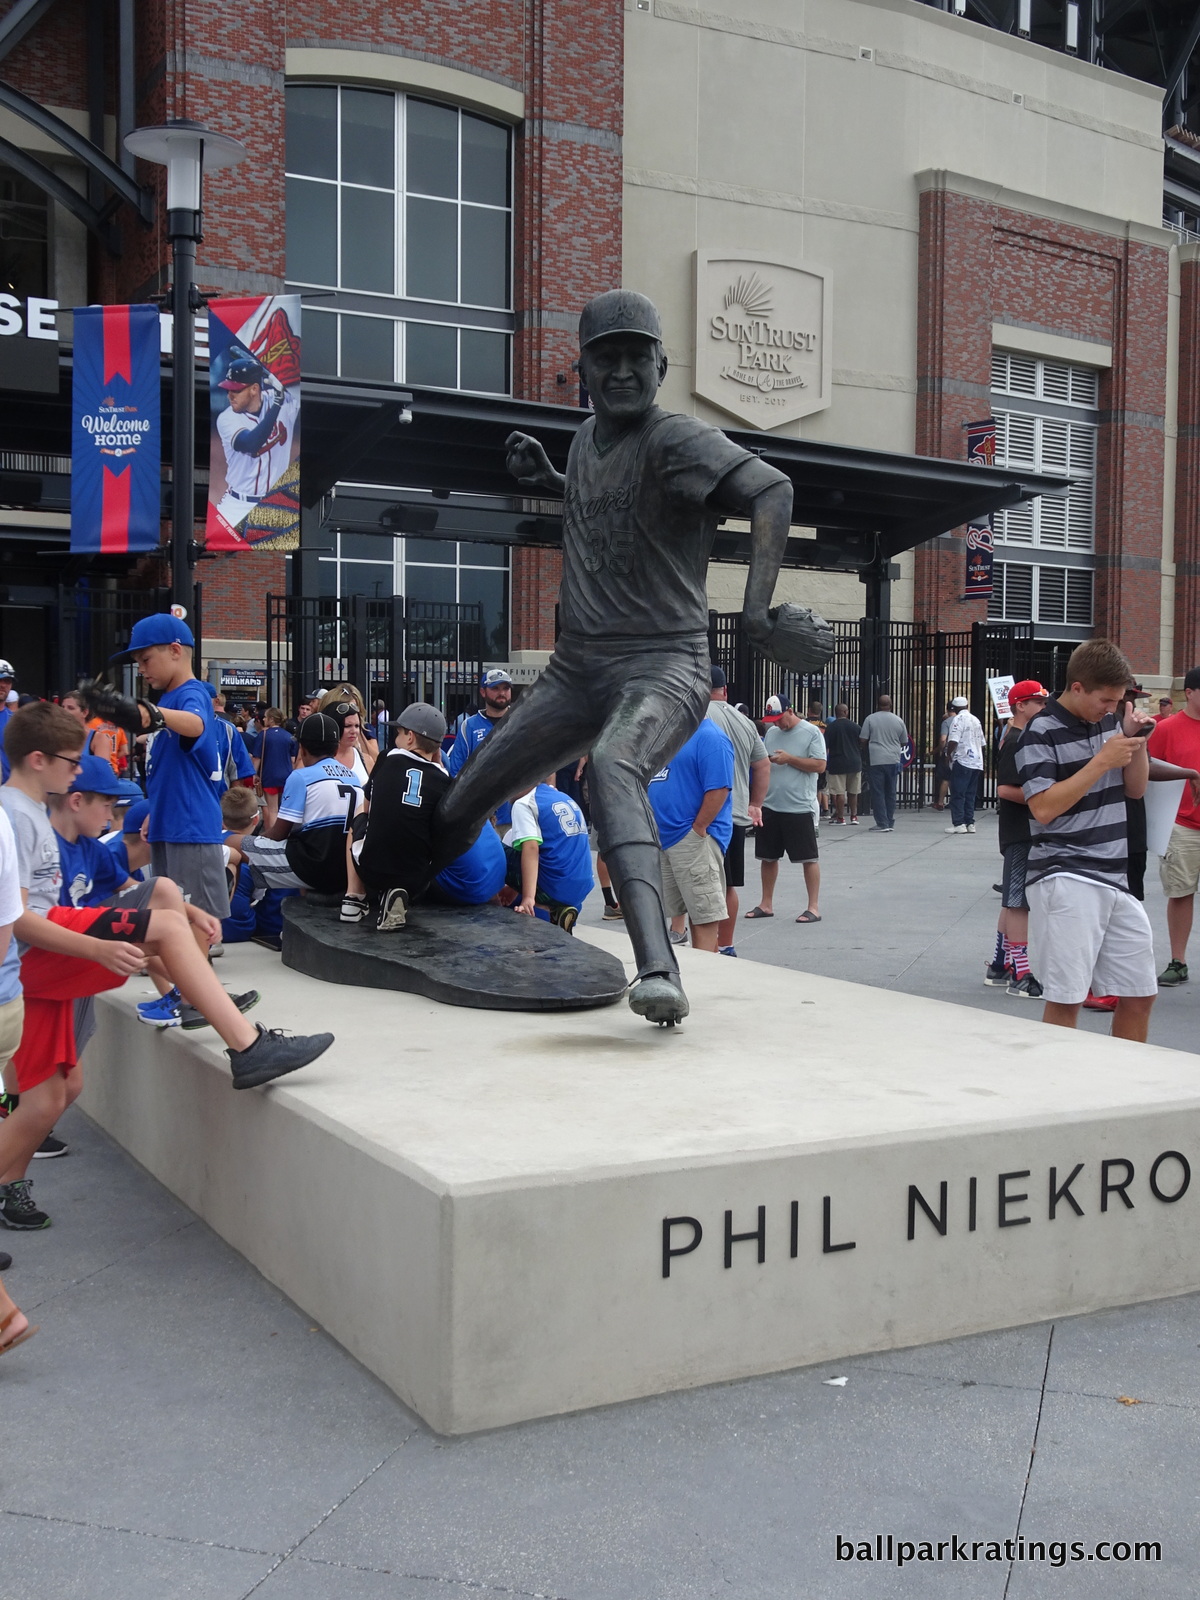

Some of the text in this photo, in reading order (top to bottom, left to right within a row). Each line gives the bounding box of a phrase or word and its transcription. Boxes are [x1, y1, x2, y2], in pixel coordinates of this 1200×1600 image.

[738, 342, 792, 374] PARK
[732, 369, 747, 382] HOME
[747, 375, 755, 384] OF
[775, 379, 785, 387] THE
[764, 397, 786, 406] 2017
[81, 413, 150, 434] Welcome
[584, 529, 636, 577] 35
[402, 768, 423, 807] 1
[662, 1150, 1191, 1279] PHIL NIEKRO
